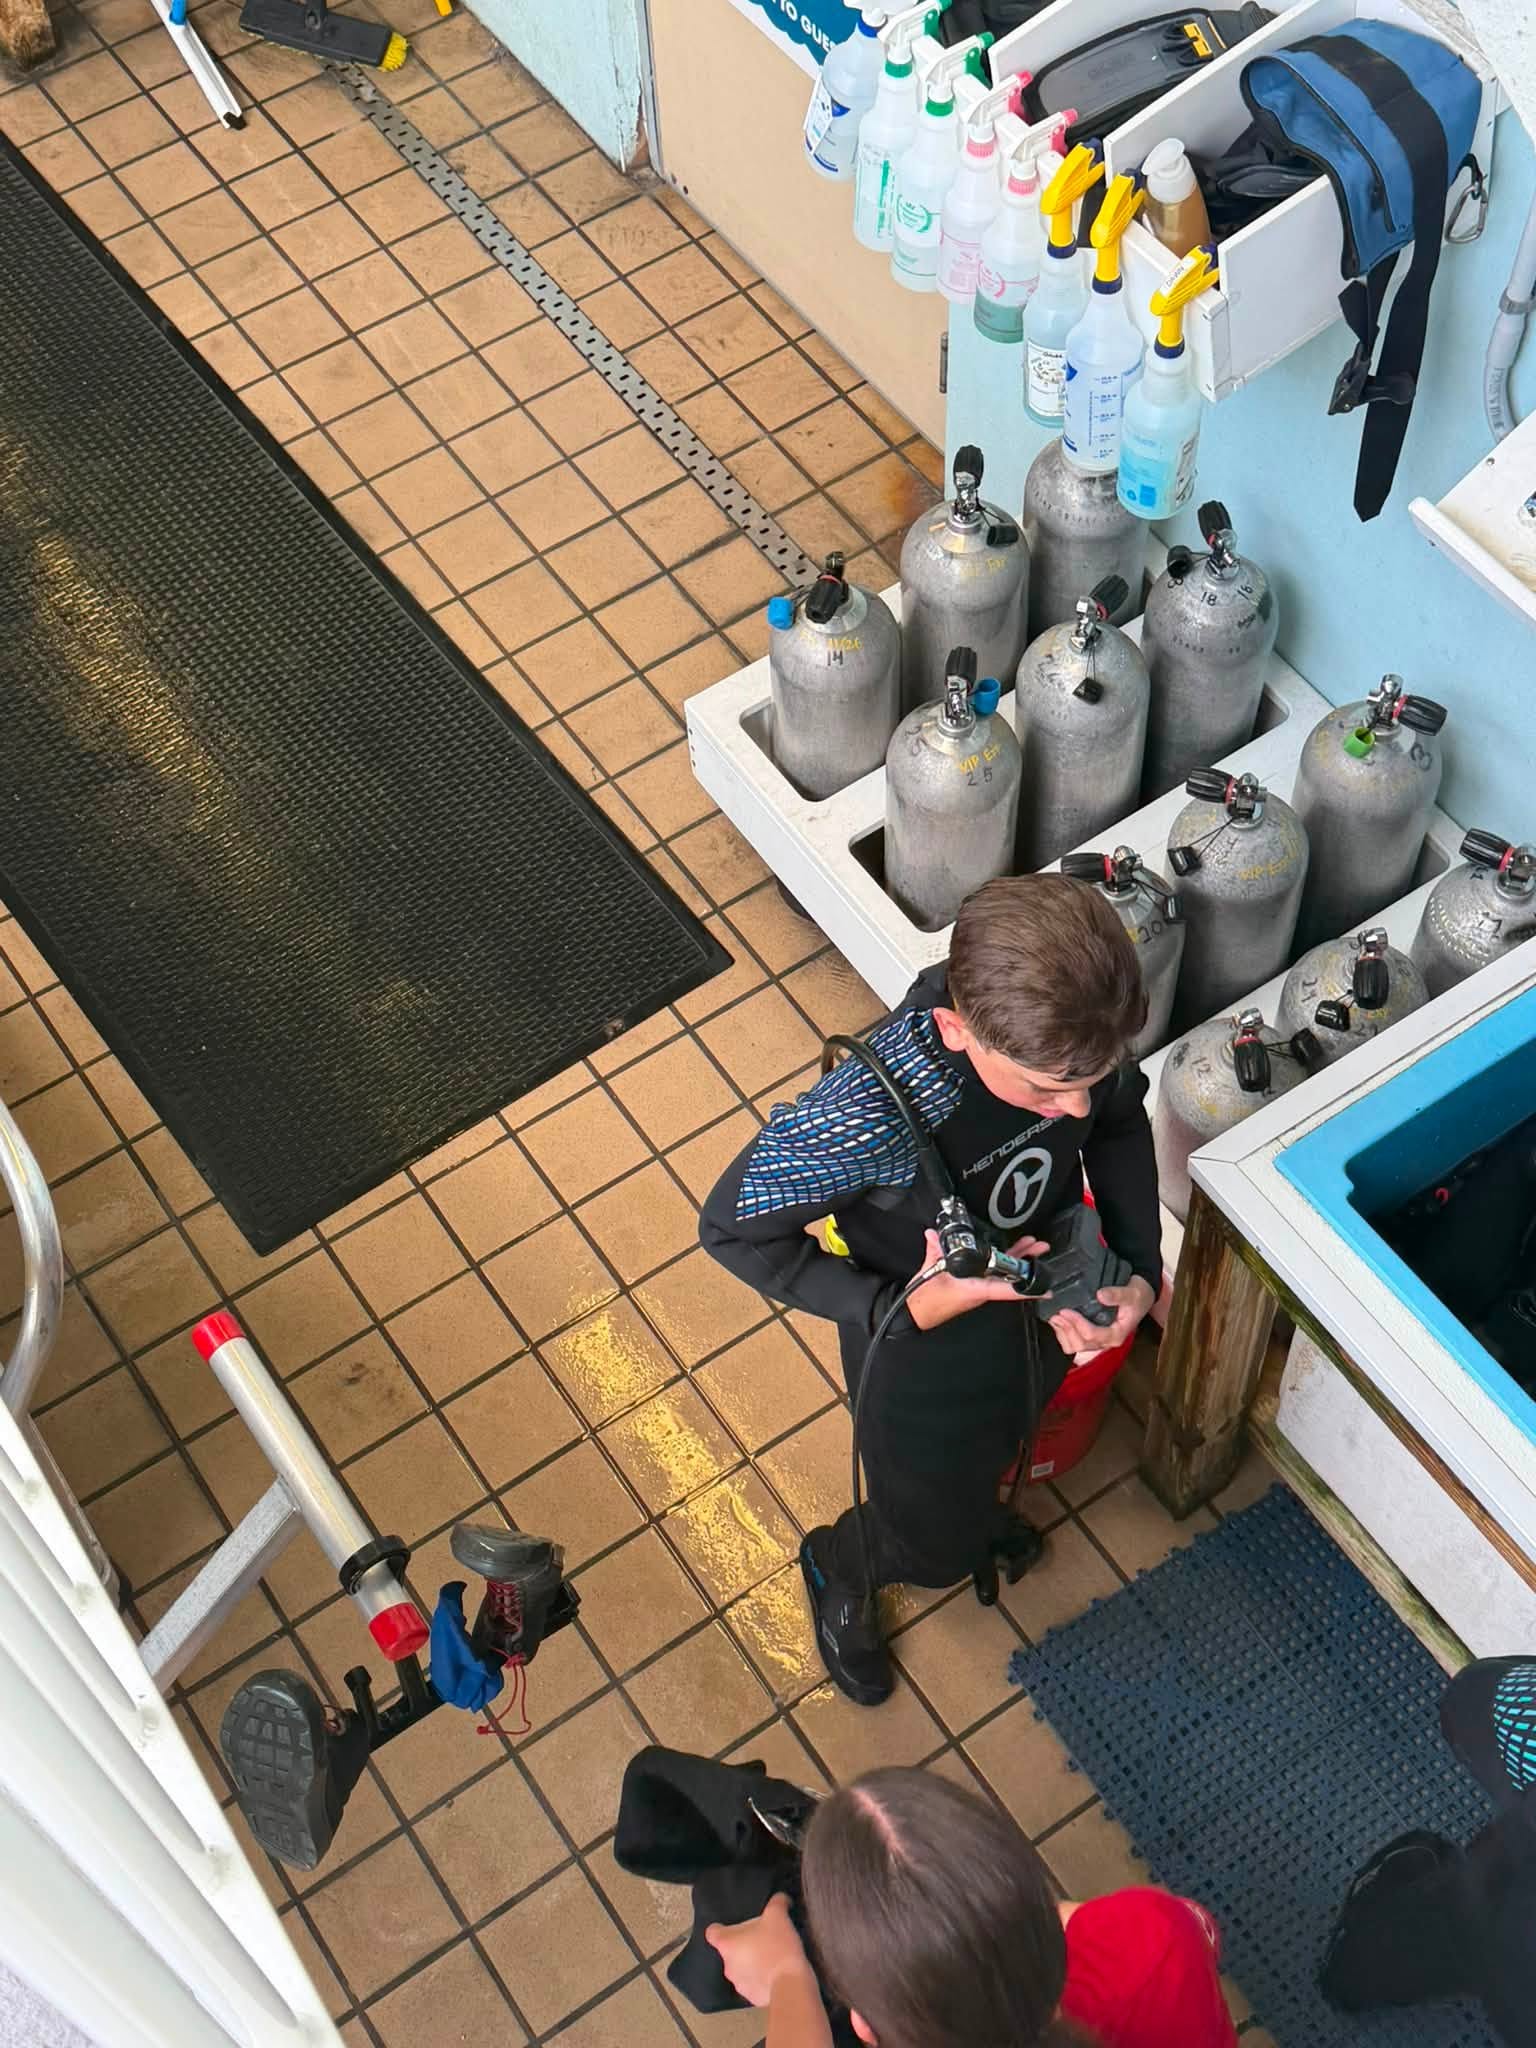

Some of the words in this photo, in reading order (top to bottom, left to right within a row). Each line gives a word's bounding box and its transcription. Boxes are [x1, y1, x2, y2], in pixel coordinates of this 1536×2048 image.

[1201, 592, 1218, 606] 18
[827, 650, 844, 667] 14
[1137, 919, 1162, 944] 20
[962, 1115, 1060, 1181] HENDERS
